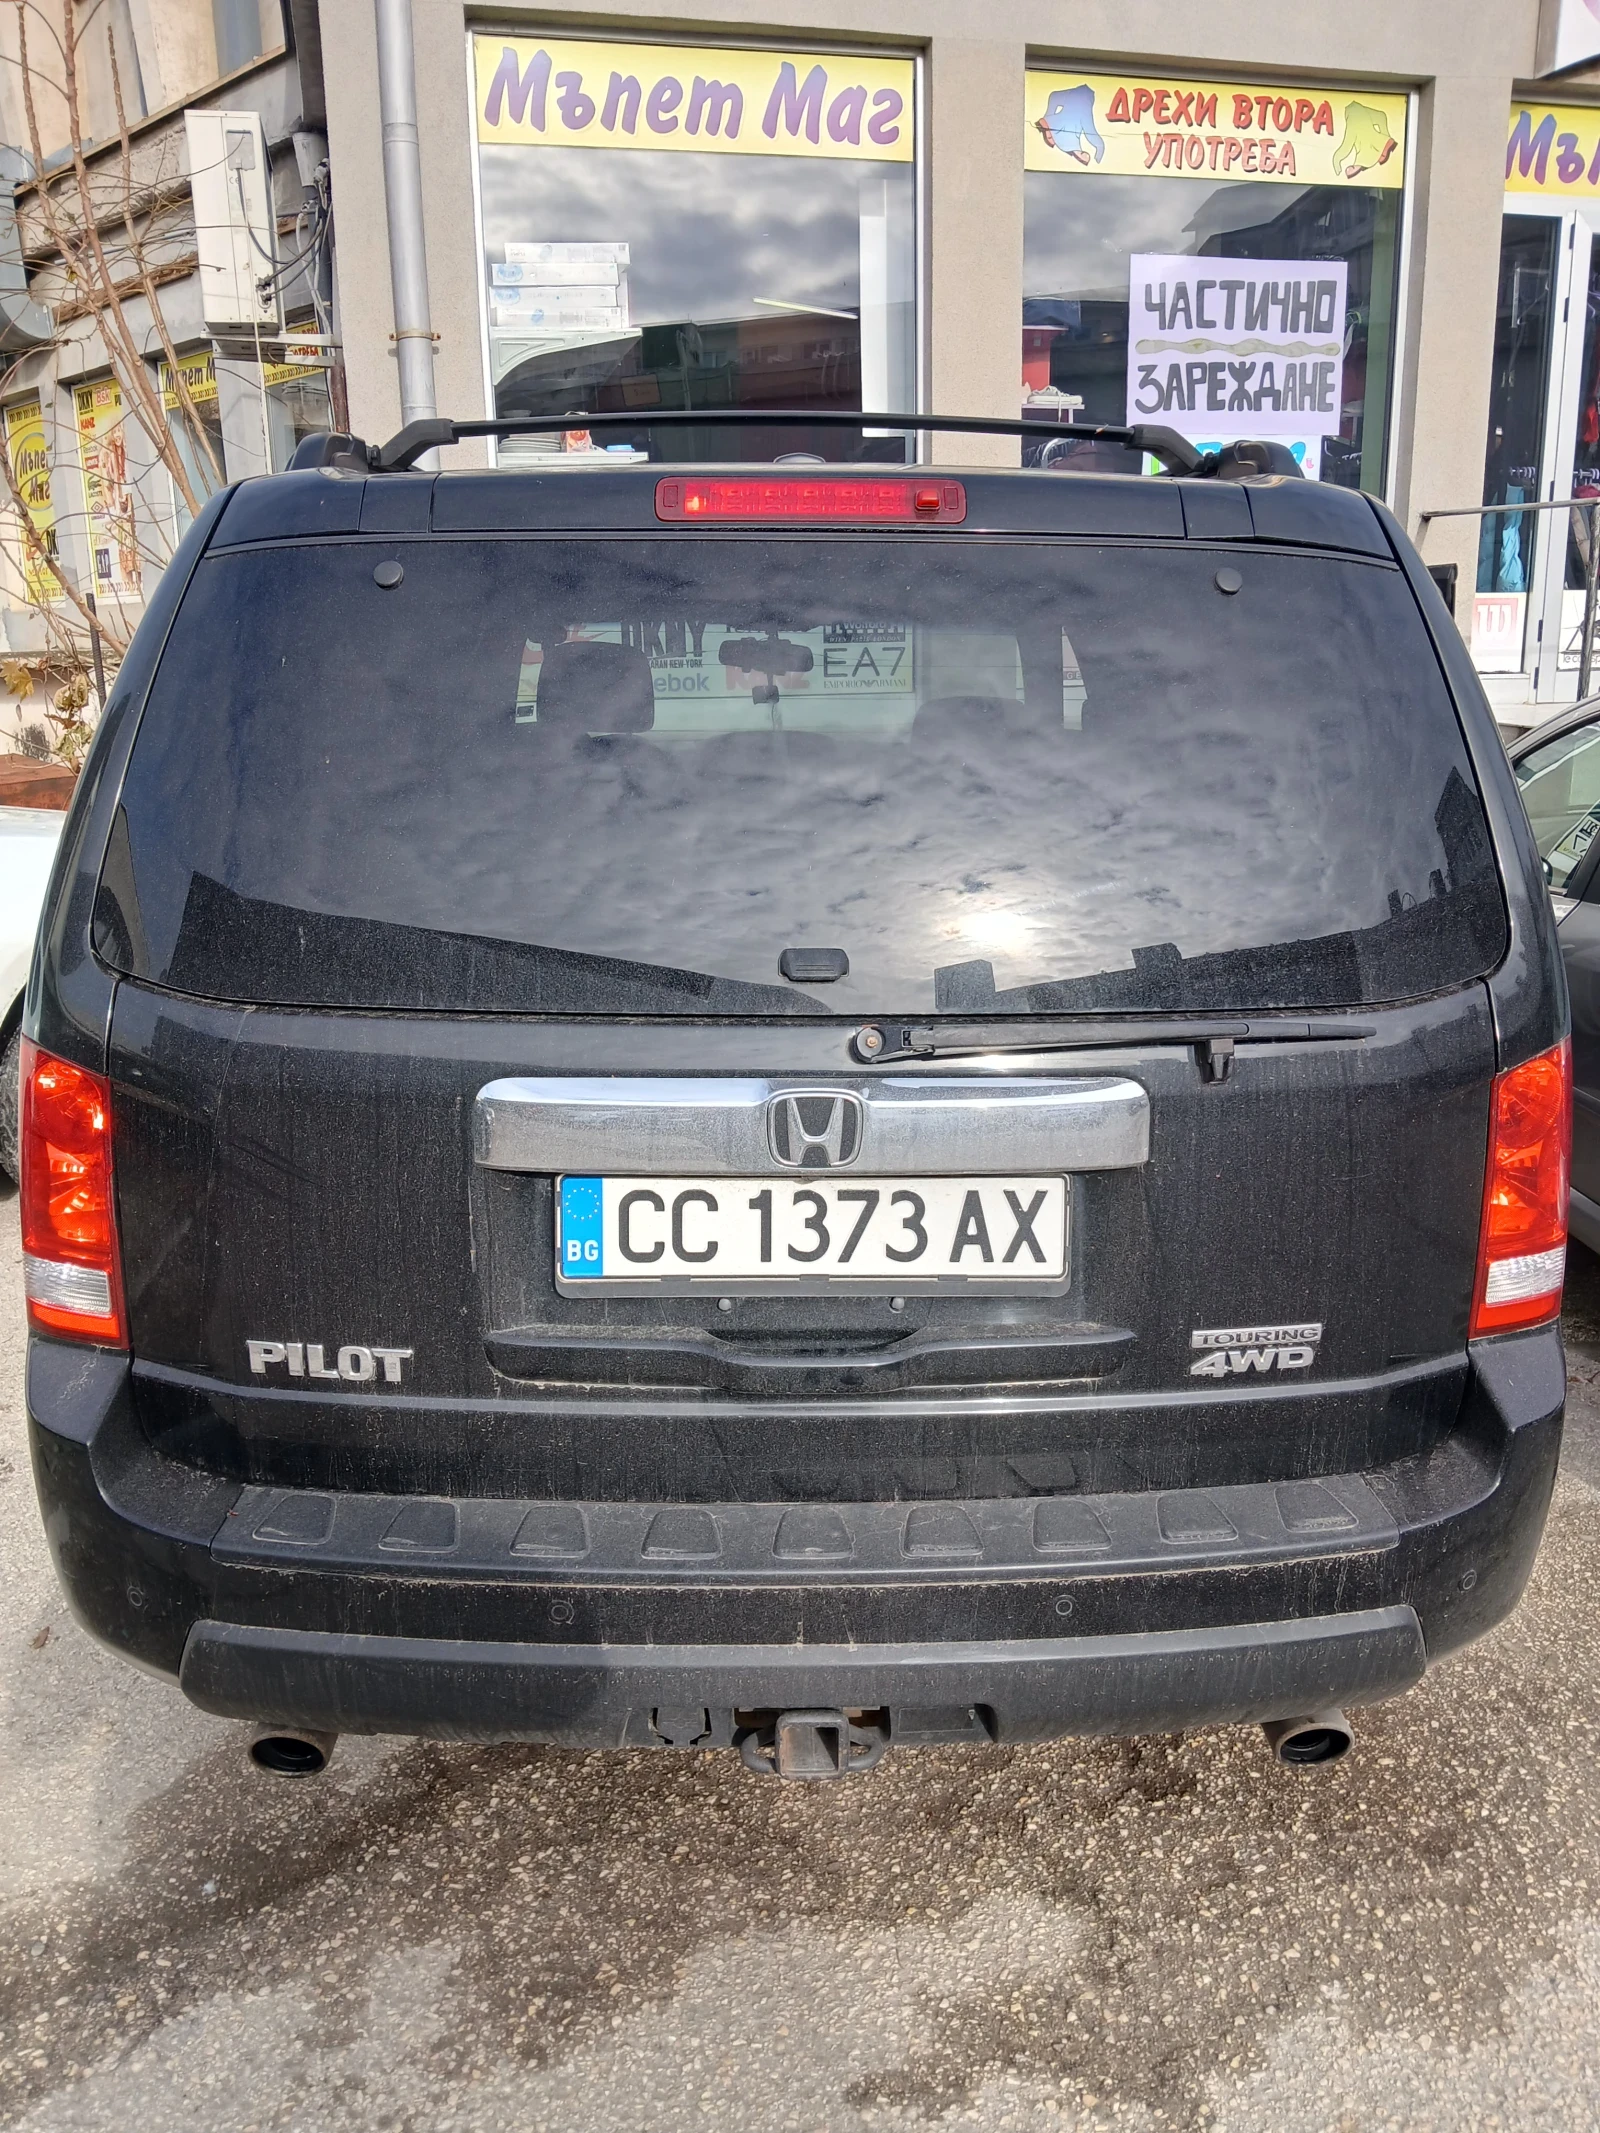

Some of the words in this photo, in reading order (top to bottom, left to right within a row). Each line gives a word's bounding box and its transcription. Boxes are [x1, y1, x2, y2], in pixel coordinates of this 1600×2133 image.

[484, 47, 743, 139] Мъпет
[762, 62, 903, 146] Маг
[1105, 86, 1218, 128] ДРЕХИ
[1233, 93, 1334, 136] ВТОРА
[1142, 131, 1297, 177] УПОТРЕБА
[1144, 280, 1338, 334] ЧАСТИЧНО
[165, 367, 203, 391] Мпет
[1134, 361, 1336, 414] ЗАРЕЖДАНЕ
[20, 448, 46, 478] Мъпе
[650, 659, 668, 669] ARAN
[686, 658, 703, 668] YORK
[824, 647, 905, 677] EA7
[653, 673, 710, 692] ebok
[566, 1239, 599, 1262] BG
[618, 1189, 718, 1263] CC
[748, 1189, 928, 1264] 1373
[949, 1189, 1047, 1264] AX
[1197, 1328, 1319, 1345] TOURING
[246, 1340, 414, 1382] PILOT
[1189, 1346, 1314, 1378] 4WD
